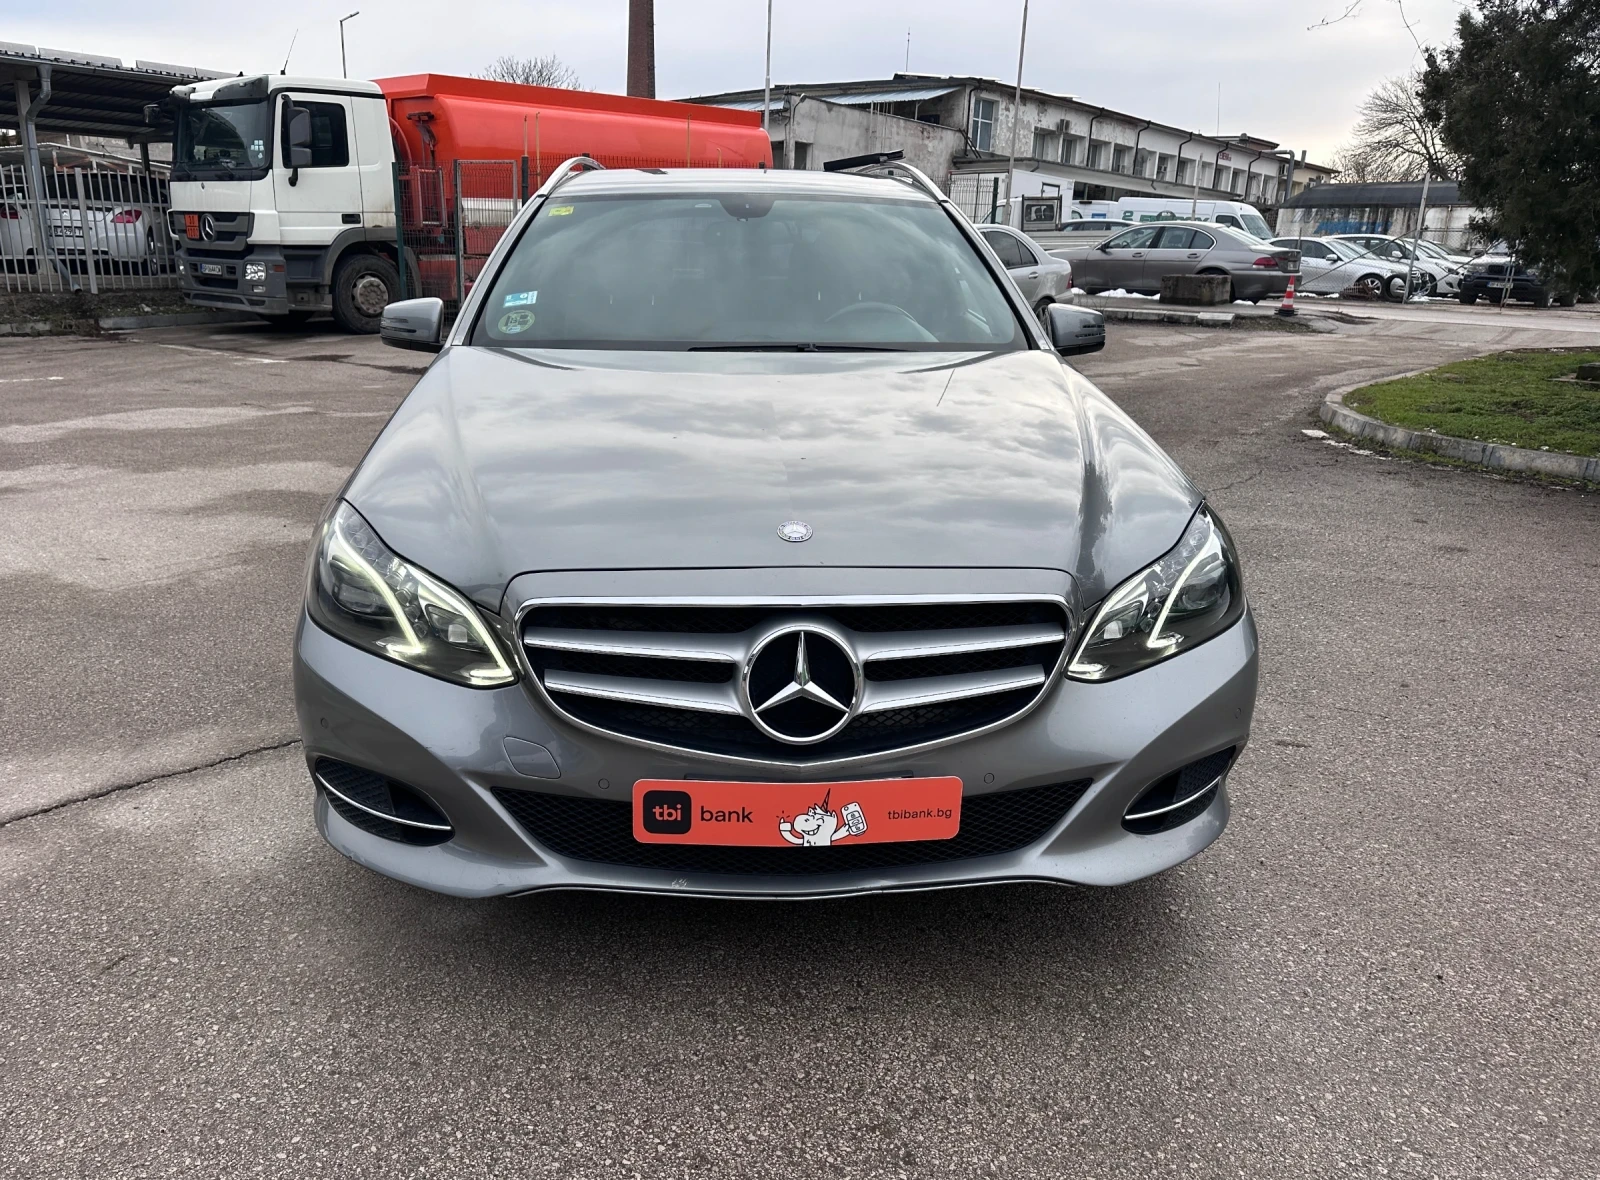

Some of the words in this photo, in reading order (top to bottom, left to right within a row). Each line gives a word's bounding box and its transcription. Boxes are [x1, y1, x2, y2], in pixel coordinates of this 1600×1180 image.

[652, 803, 682, 821] tbi
[700, 805, 754, 823] bank
[888, 808, 952, 820] tbibank.bg
